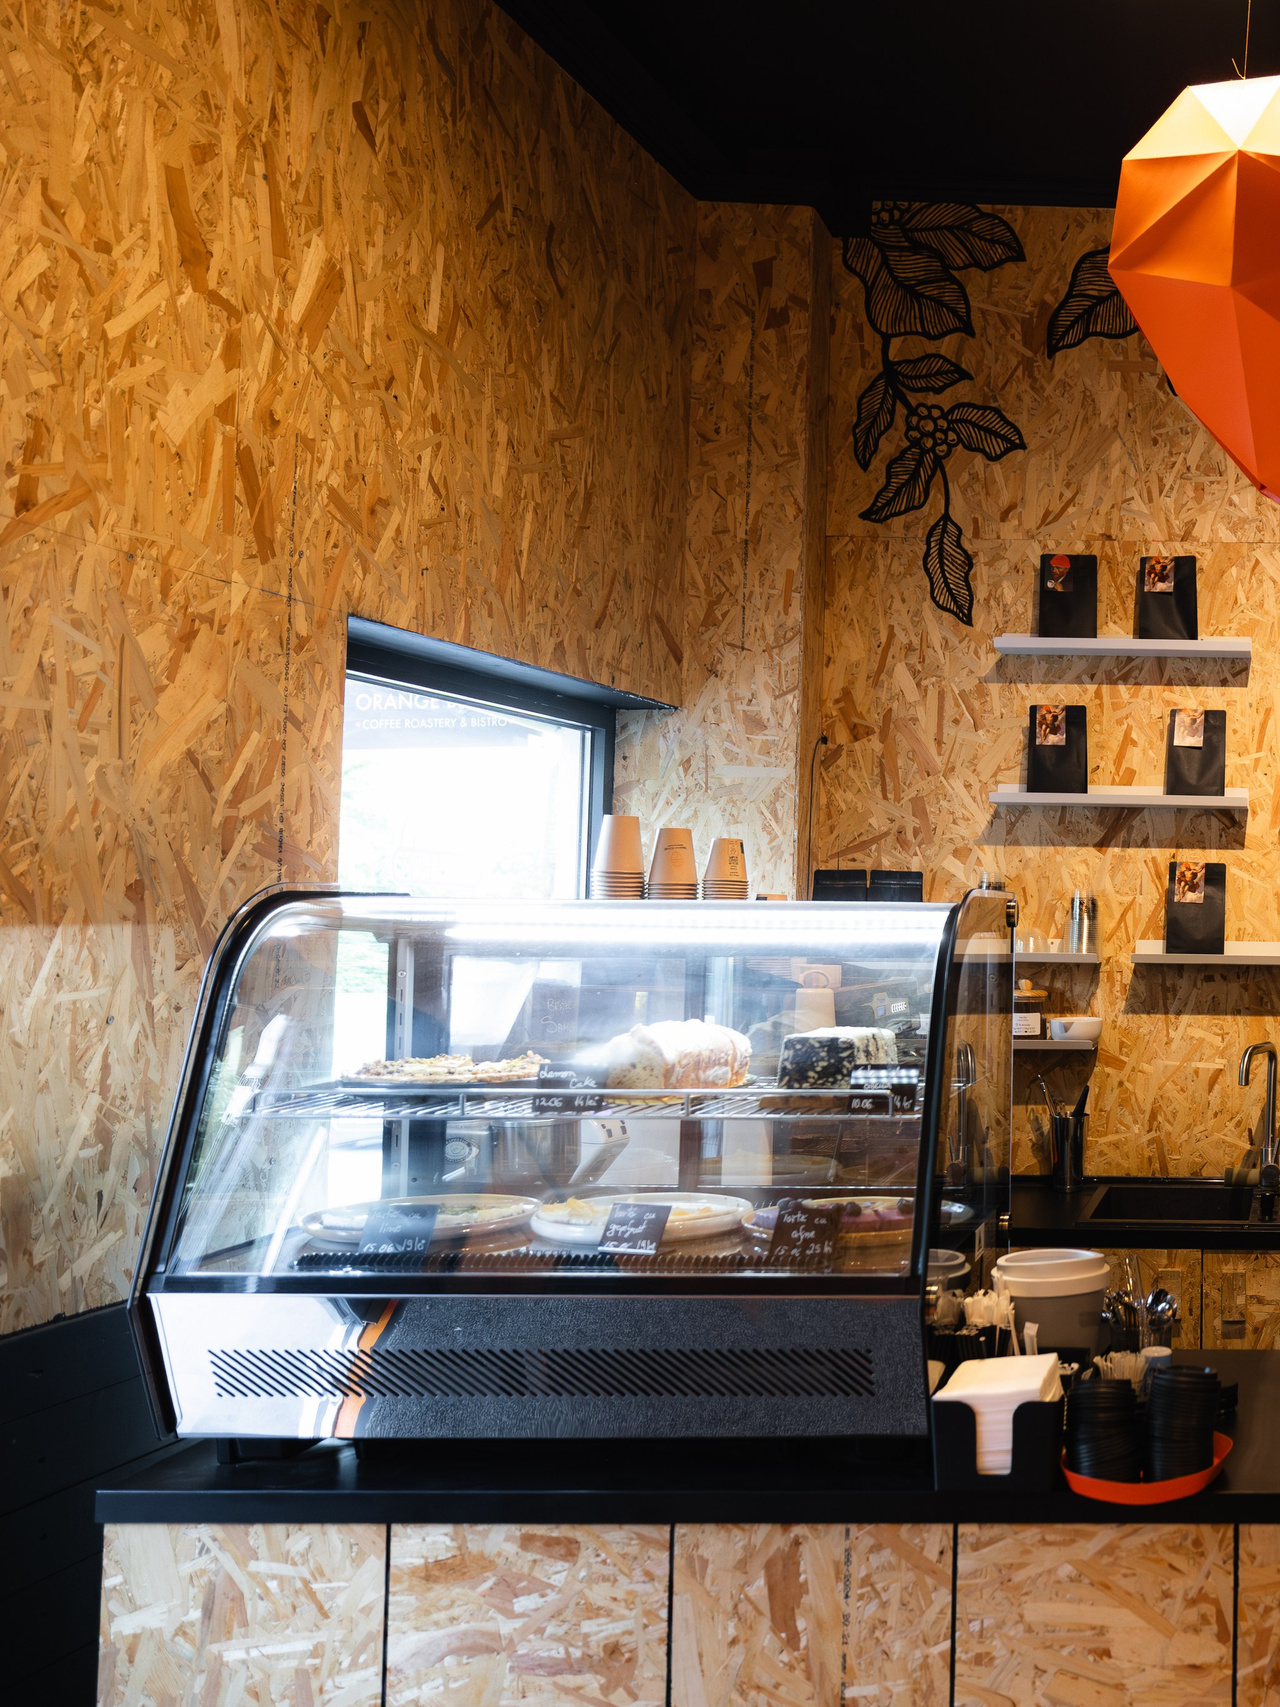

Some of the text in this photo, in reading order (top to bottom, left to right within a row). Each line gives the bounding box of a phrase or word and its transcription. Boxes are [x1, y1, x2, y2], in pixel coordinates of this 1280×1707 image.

[355, 692, 440, 711] ORANGE
[362, 716, 507, 730] COFFEE ROASTERY & BISTRO
[539, 1064, 577, 1079] Lemon
[569, 1075, 598, 1089] Cake
[643, 1212, 657, 1220] cu
[813, 1217, 827, 1225] cu
